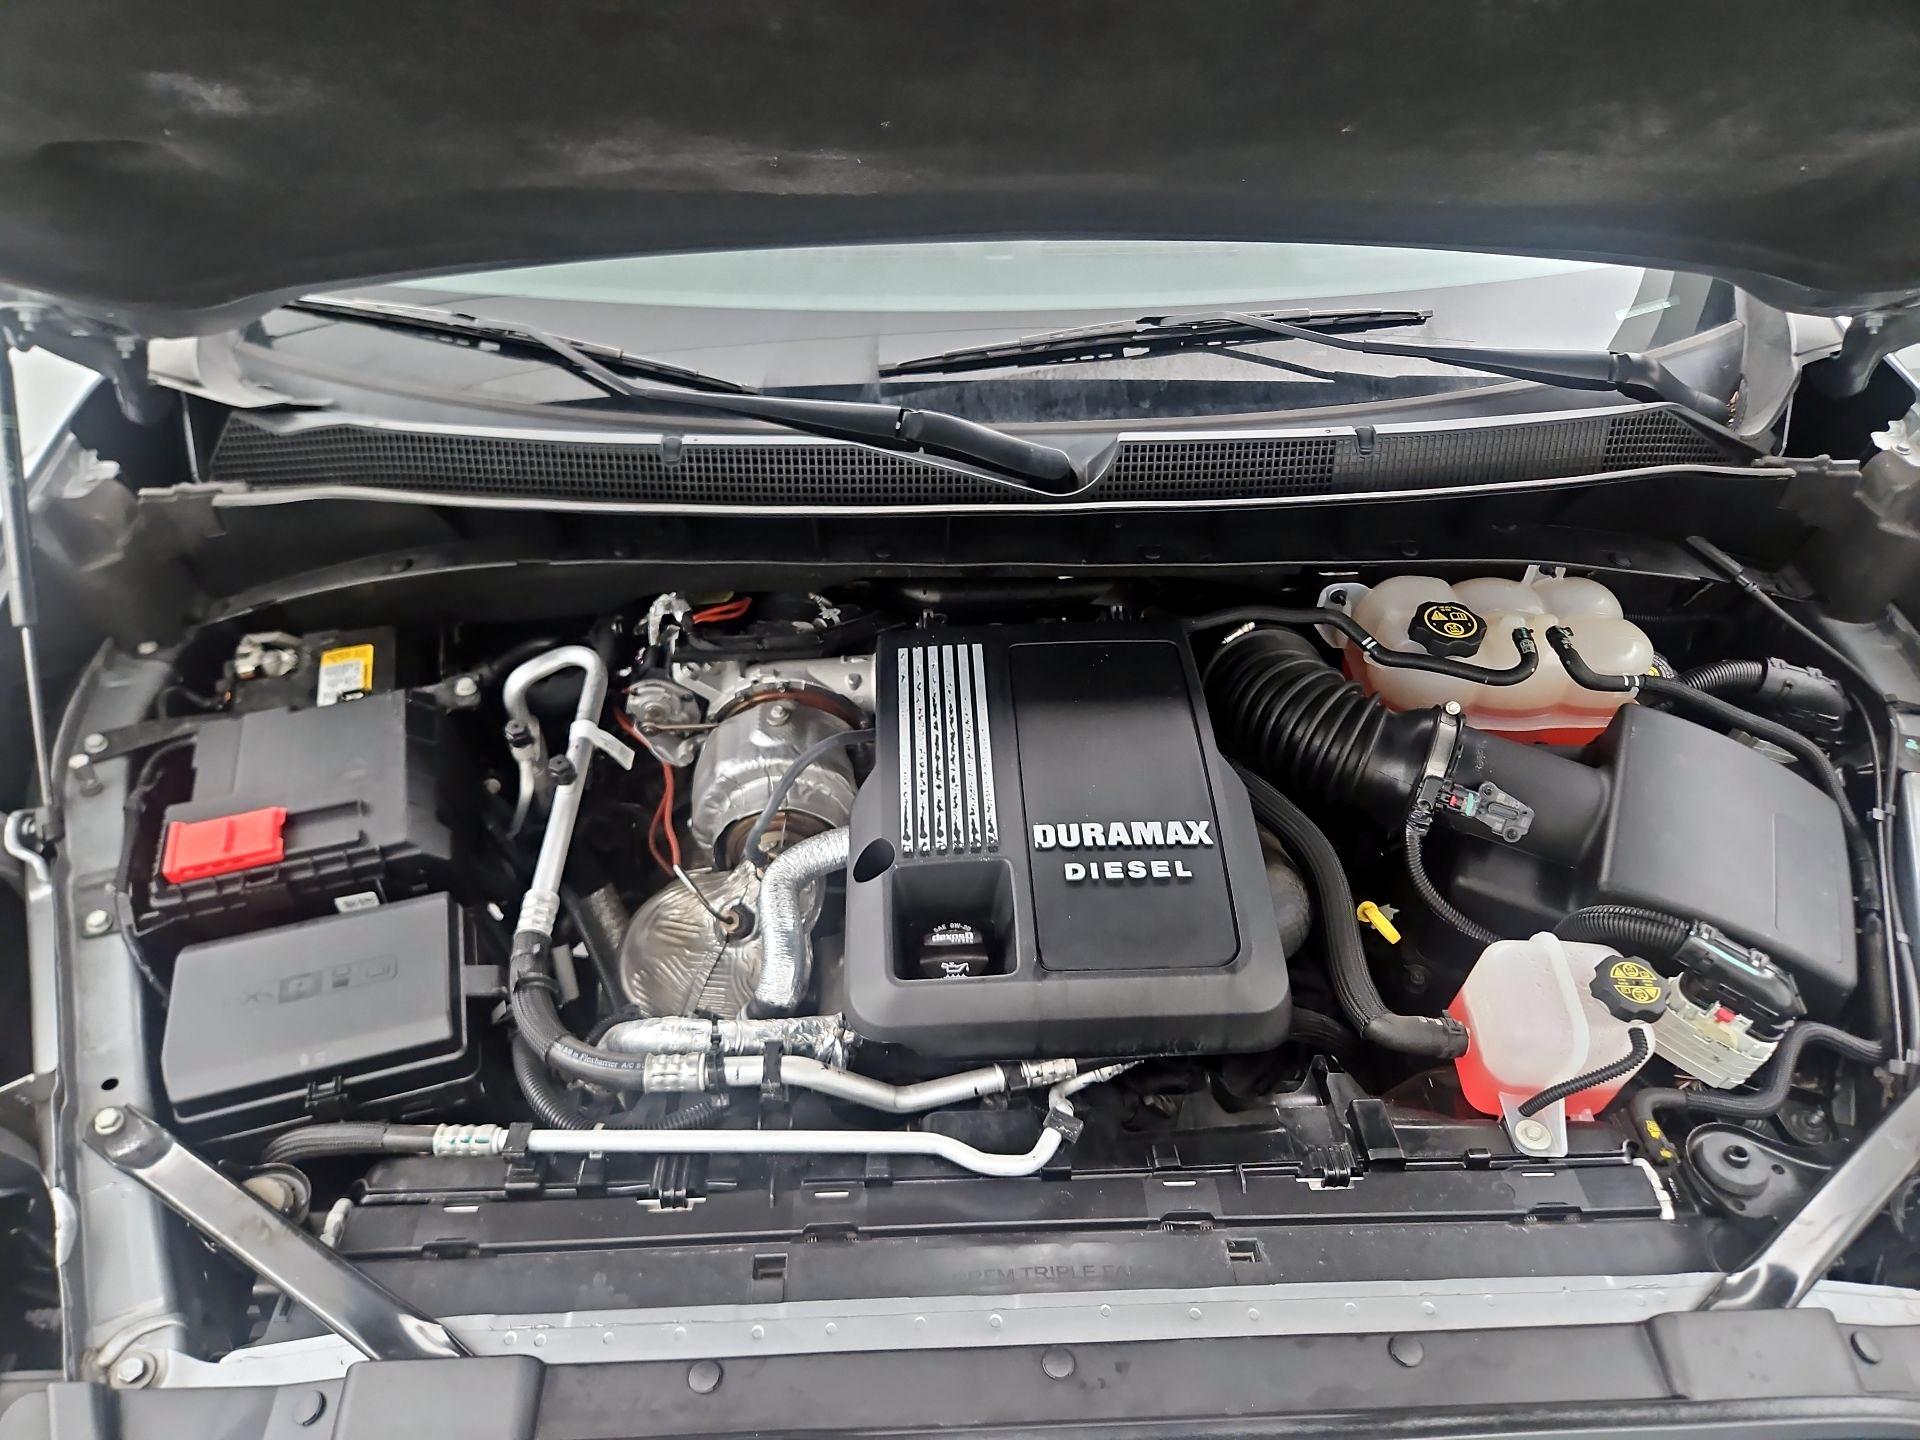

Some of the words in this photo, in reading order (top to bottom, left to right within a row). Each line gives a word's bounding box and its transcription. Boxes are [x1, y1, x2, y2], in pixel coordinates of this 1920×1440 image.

[1033, 821, 1214, 849] DURAMAX
[1064, 860, 1193, 881] DIESEL
[1020, 1264, 1096, 1281] TRIPLE
